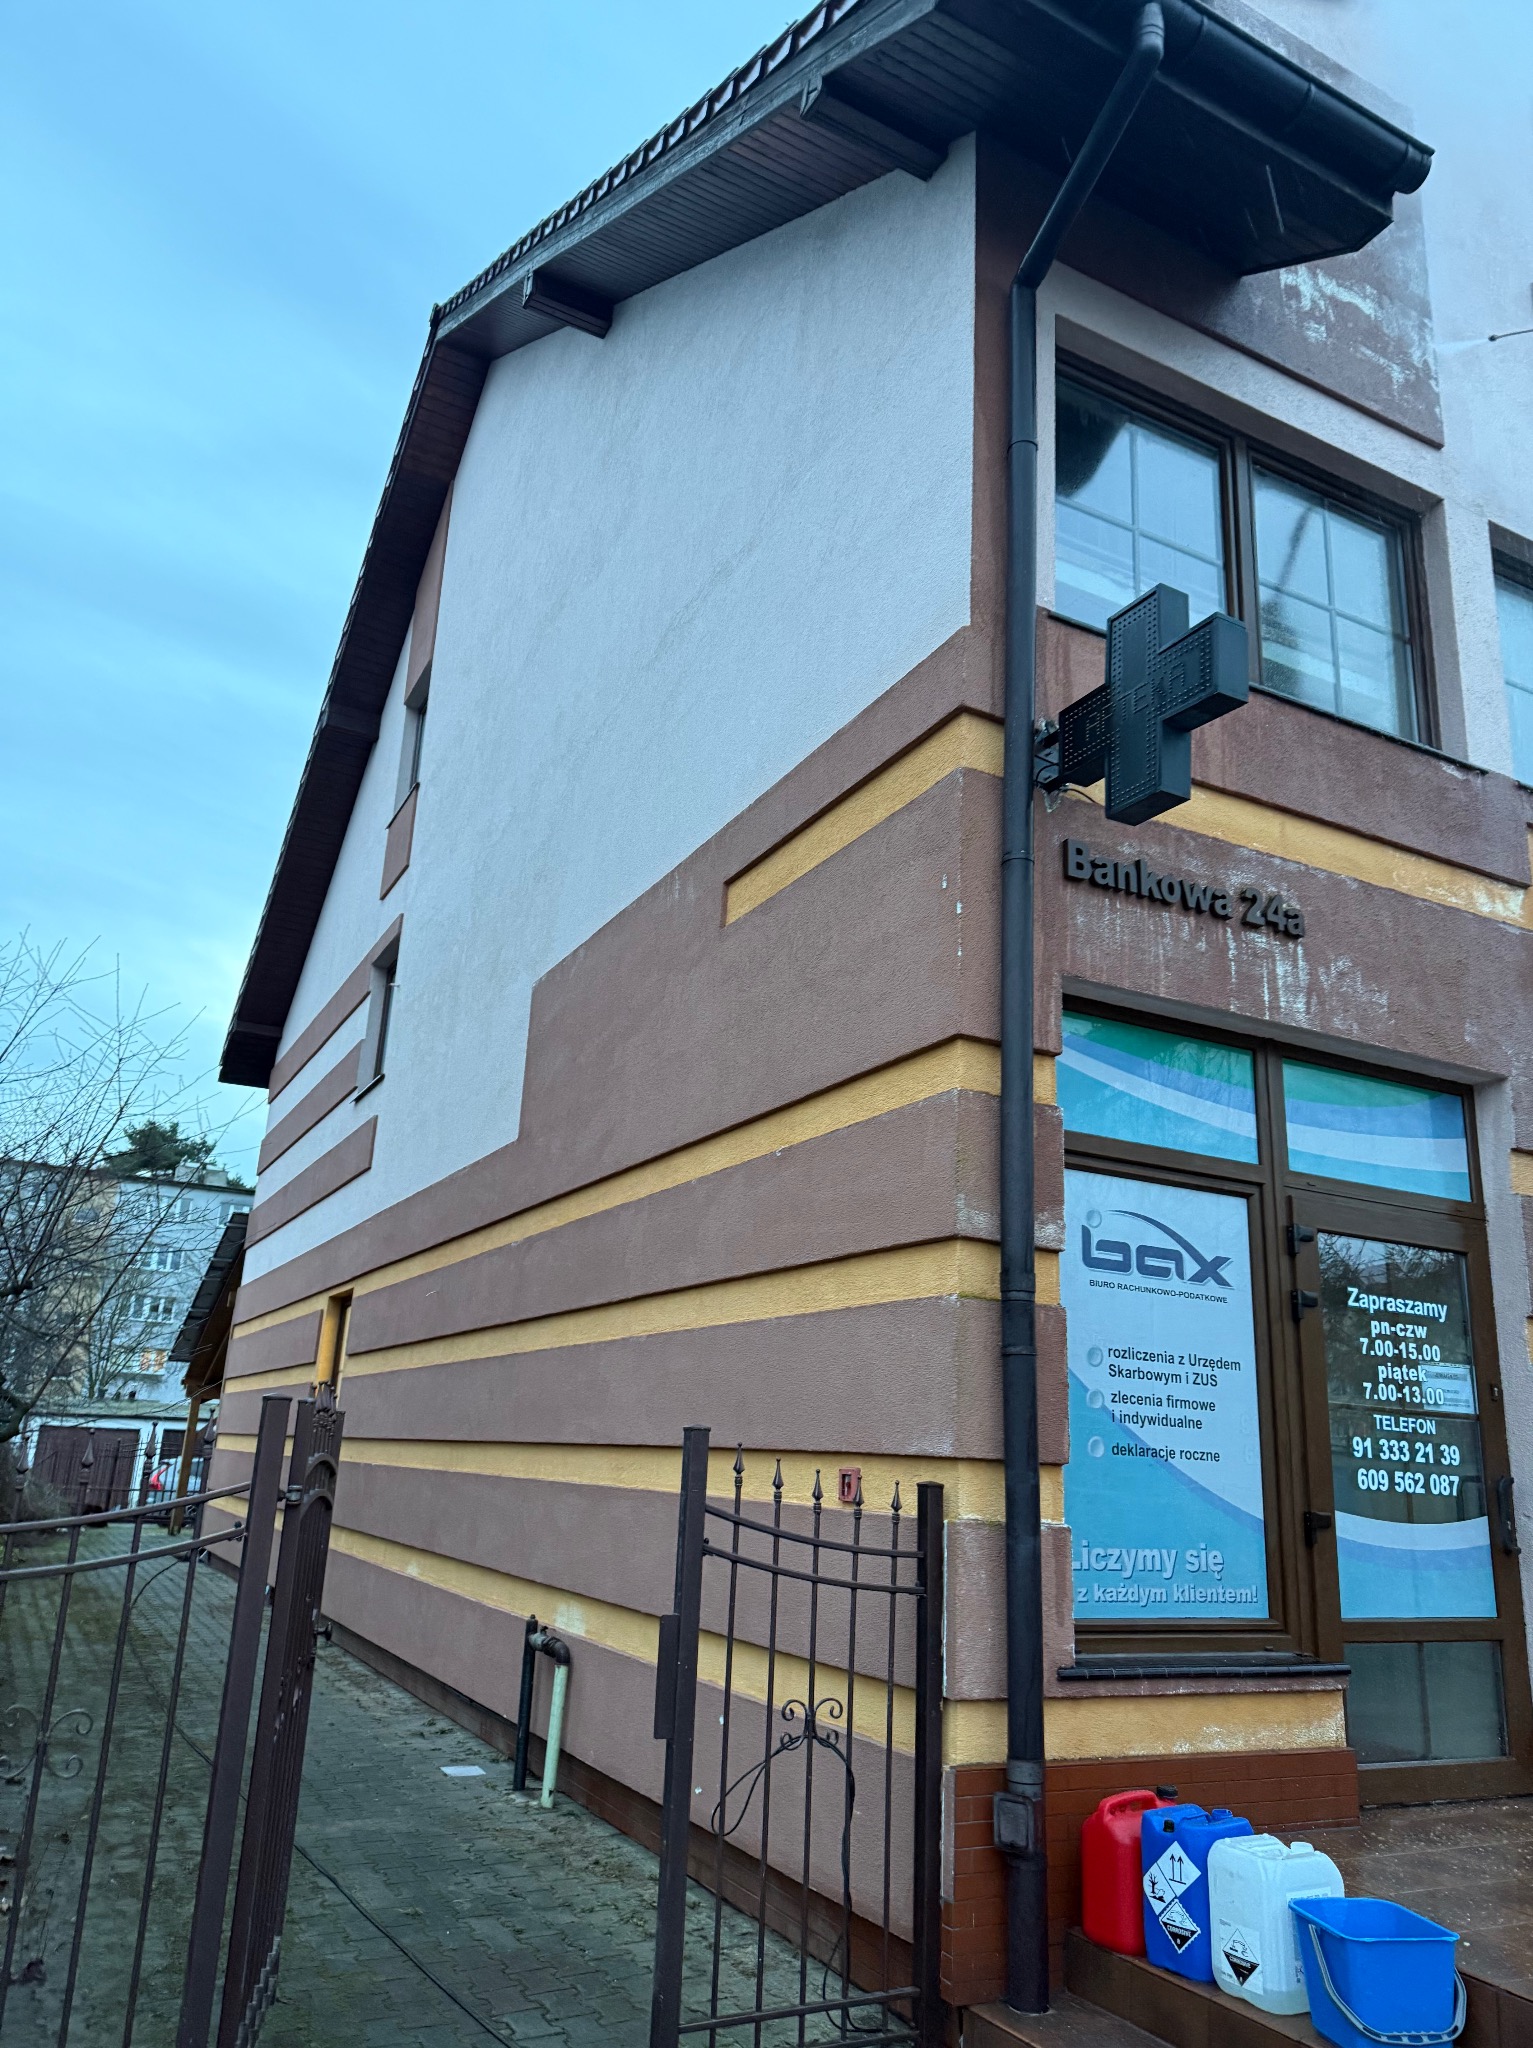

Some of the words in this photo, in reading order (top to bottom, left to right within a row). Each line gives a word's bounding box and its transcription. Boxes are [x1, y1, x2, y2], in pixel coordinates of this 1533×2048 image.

[1063, 838, 1234, 920] Bankowa
[1240, 887, 1305, 939] 24a
[1081, 1209, 1234, 1288] bax
[1089, 1279, 1116, 1289] BIURO
[1117, 1282, 1228, 1304] RACHUNKOWO-PODATKOWE
[1347, 1286, 1448, 1323] Zapraszamy
[1370, 1320, 1428, 1338] pn-czw
[1108, 1346, 1175, 1365] rozliczenia
[1178, 1355, 1185, 1365] z
[1188, 1353, 1241, 1372] Urzędem
[1360, 1337, 1441, 1361] 7.00-15.00
[1108, 1363, 1182, 1385] Skarbowym
[1192, 1372, 1218, 1387] ZUS
[1378, 1362, 1428, 1385] piątek
[1110, 1390, 1163, 1407] zlecenia
[1166, 1394, 1216, 1412] firmowe
[1362, 1382, 1445, 1405] 7.00-13.00
[1119, 1409, 1203, 1430] indywidualne
[1373, 1414, 1437, 1435] TELEFON
[1111, 1442, 1176, 1462] deklaracje
[1179, 1449, 1220, 1462] roczne
[1352, 1436, 1373, 1459] 91
[1378, 1438, 1410, 1461] 333
[1414, 1441, 1434, 1464] 21
[1439, 1444, 1460, 1466] 39
[1357, 1467, 1389, 1491] 609
[1394, 1471, 1426, 1494] 562
[1429, 1473, 1460, 1497] 087
[1185, 1542, 1225, 1580] się
[1077, 1586, 1089, 1603] z
[1094, 1583, 1168, 1607] każdym
[1173, 1583, 1259, 1604] klientem!
